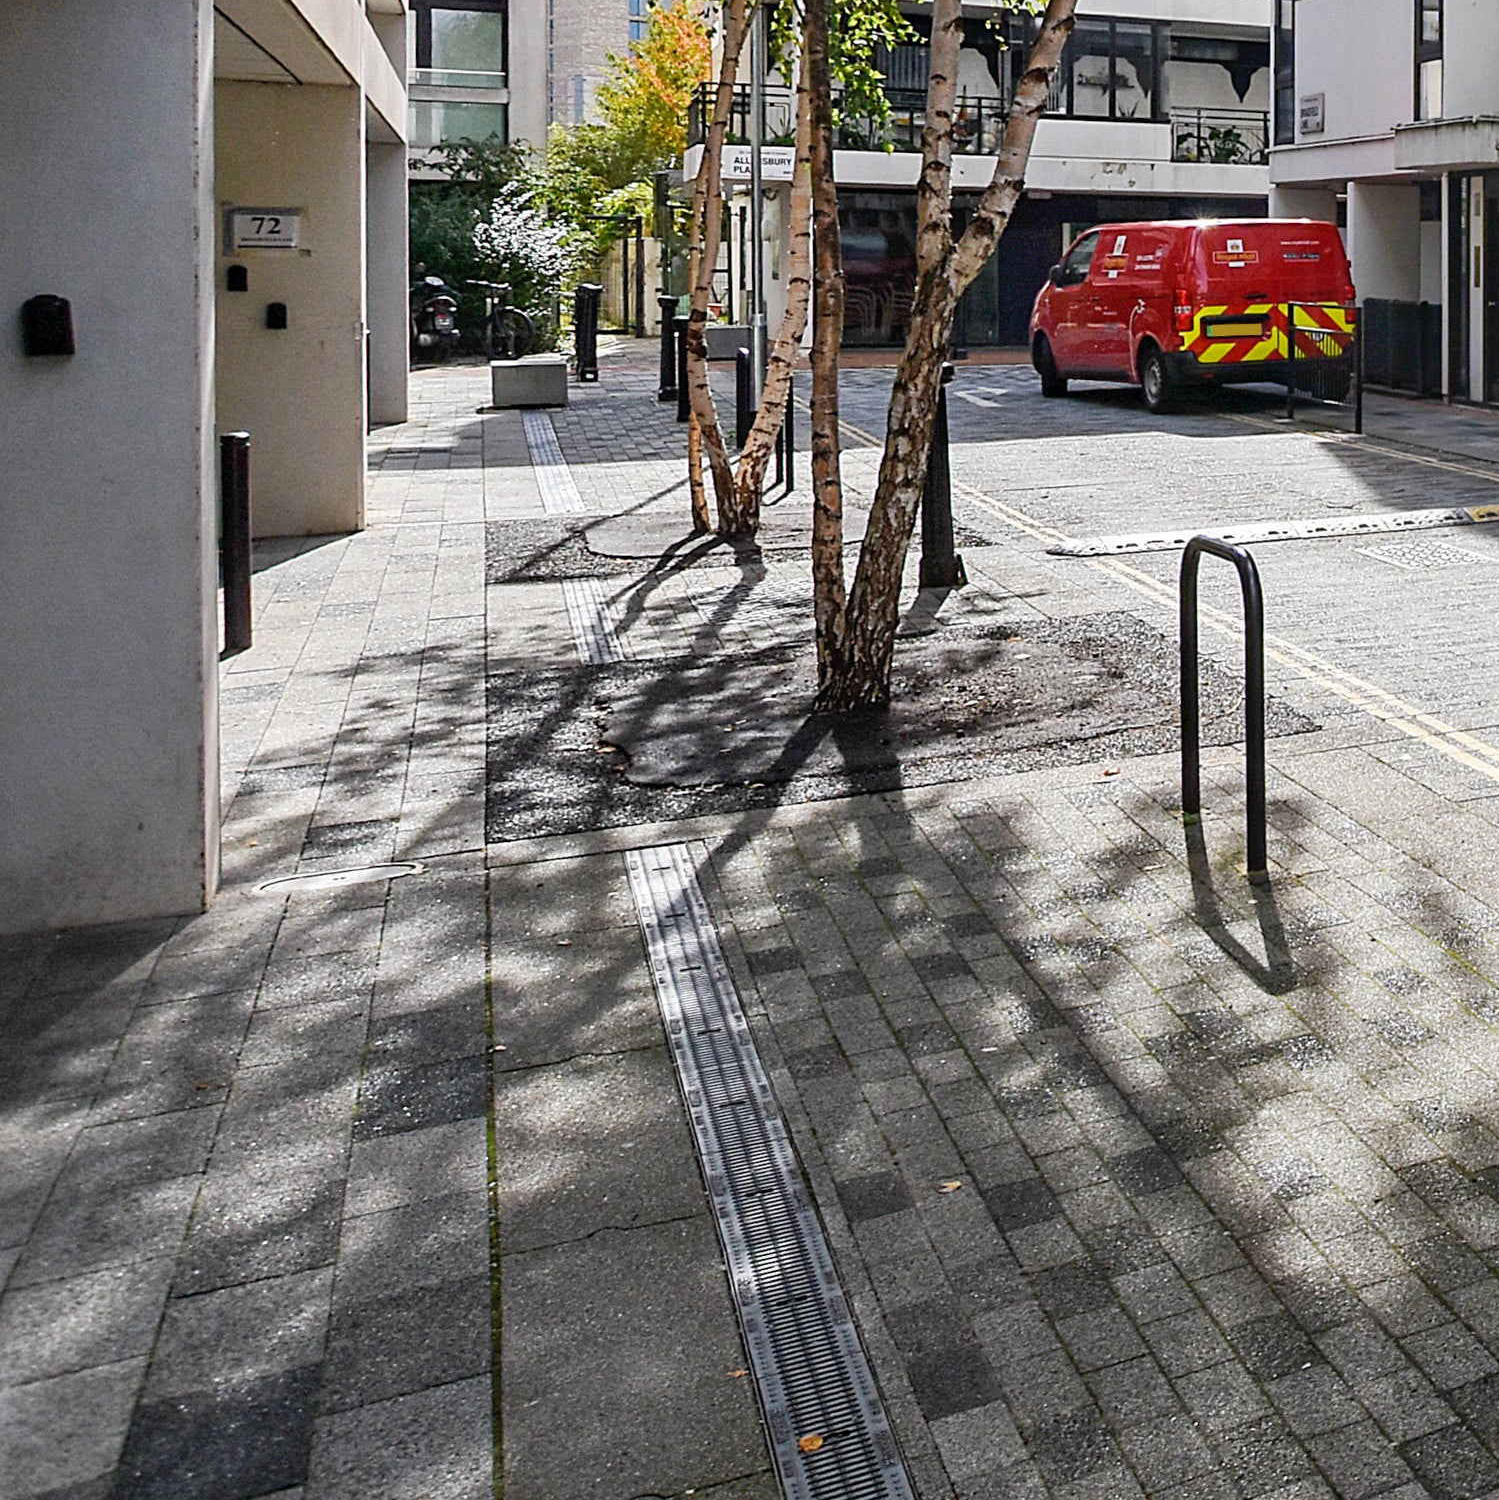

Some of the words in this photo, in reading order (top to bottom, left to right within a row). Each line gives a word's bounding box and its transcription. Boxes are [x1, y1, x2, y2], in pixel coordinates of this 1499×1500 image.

[734, 156, 791, 166] ALLSBURY
[733, 165, 752, 174] PLA
[251, 216, 281, 234] 72
